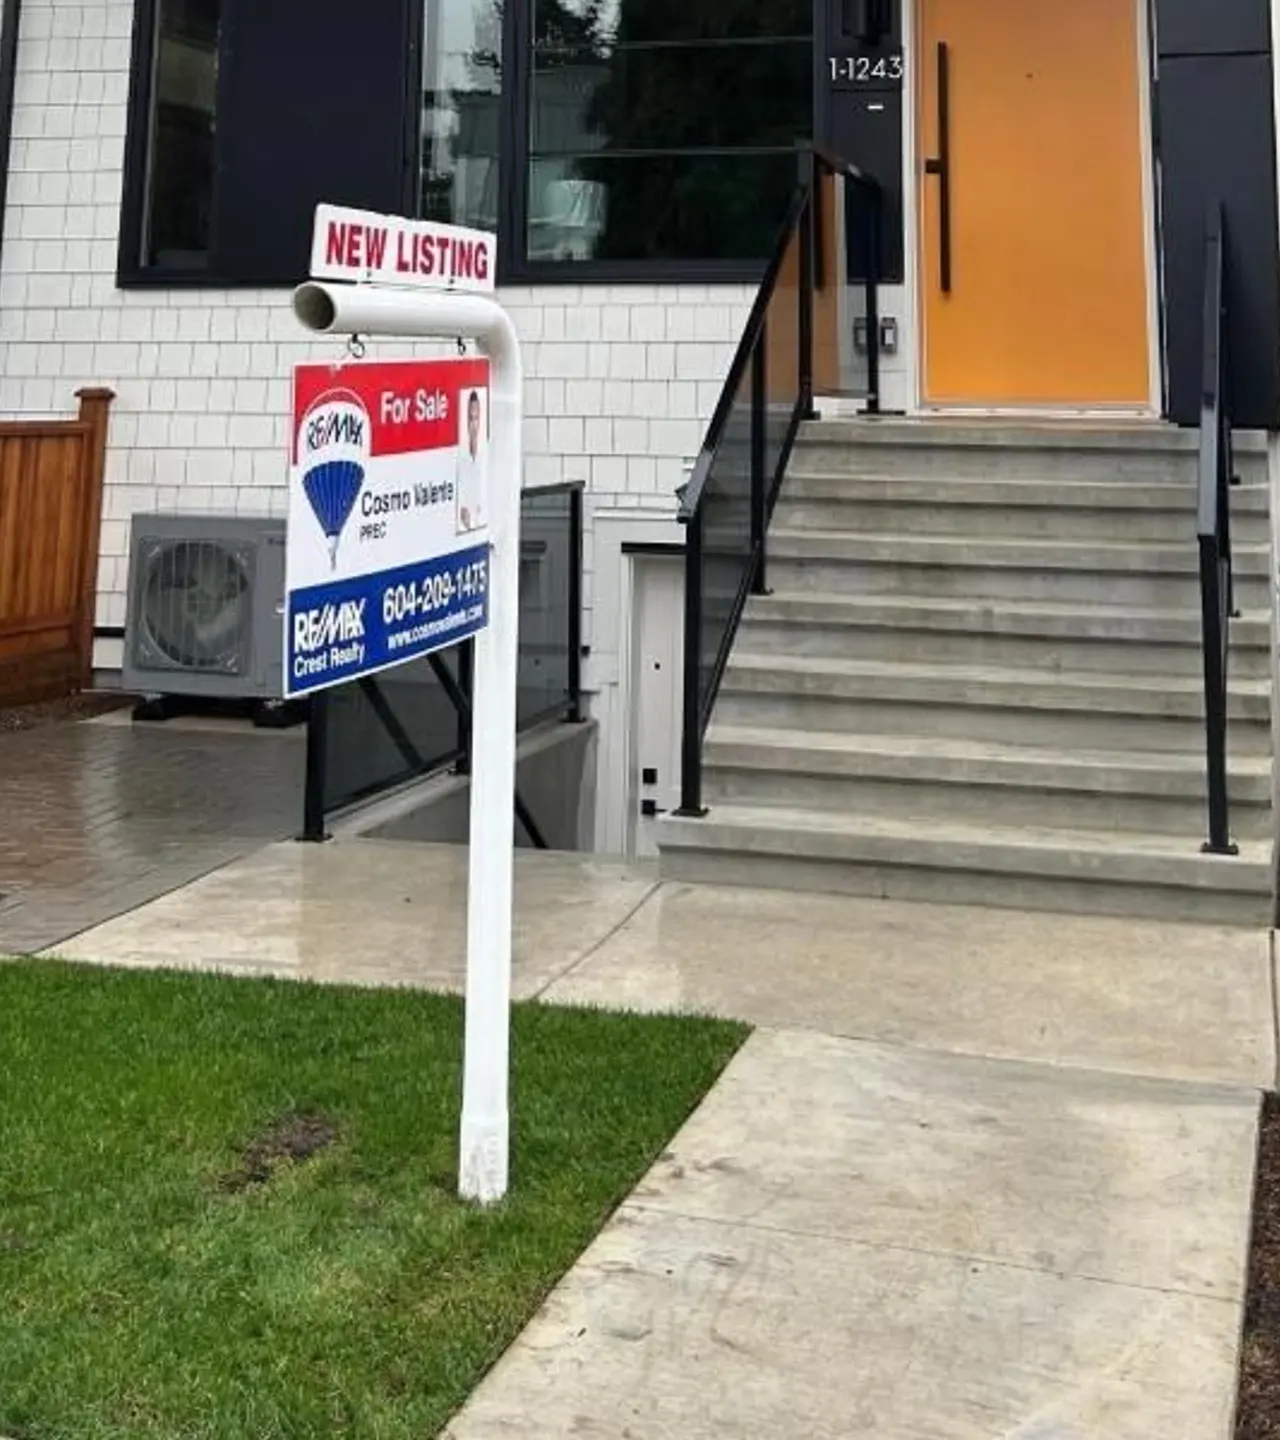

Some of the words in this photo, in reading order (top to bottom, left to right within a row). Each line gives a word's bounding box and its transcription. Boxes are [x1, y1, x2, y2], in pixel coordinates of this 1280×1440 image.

[828, 56, 903, 81] 1-1243
[325, 221, 388, 271] NEW
[395, 230, 489, 280] LISTING
[380, 390, 412, 424] For
[415, 388, 450, 420] Sale
[361, 490, 411, 517] Cosmo
[294, 597, 367, 654] RE/MAX
[294, 654, 328, 678] Crest
[330, 641, 366, 665] Realty
